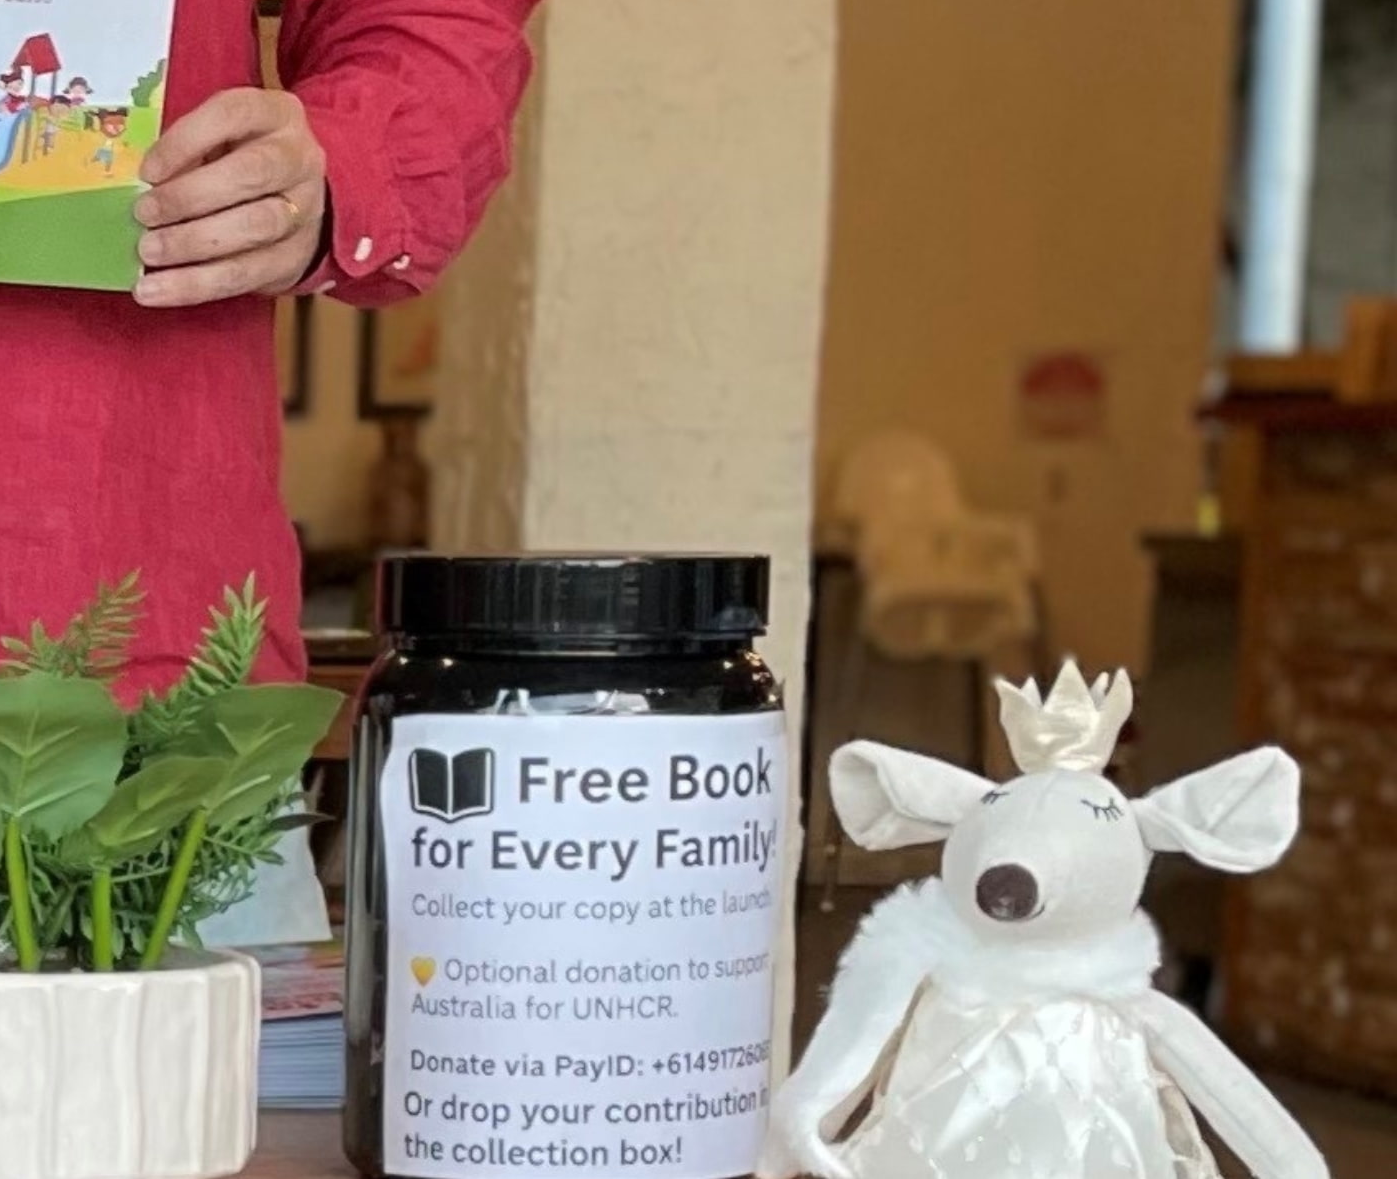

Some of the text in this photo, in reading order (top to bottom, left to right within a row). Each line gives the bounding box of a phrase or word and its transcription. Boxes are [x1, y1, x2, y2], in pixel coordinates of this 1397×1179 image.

[518, 747, 772, 804] Free Book
[411, 820, 778, 881] for Every Family!
[411, 894, 495, 919] Collect
[503, 897, 568, 925] your
[574, 896, 639, 925] copy
[648, 896, 674, 919] at
[680, 892, 717, 916] the
[444, 959, 557, 987] Optional
[566, 959, 681, 984] donation
[688, 958, 710, 981] to
[411, 994, 679, 1020] Australia for UNHCR.
[410, 1049, 496, 1077] Donate
[504, 1053, 545, 1077] via
[555, 1055, 645, 1083] PayID:
[404, 1090, 434, 1119] Or
[441, 1095, 511, 1129] drop
[521, 1099, 595, 1130] your
[605, 1084, 757, 1124] contribution
[404, 1132, 683, 1167] the collection box!
